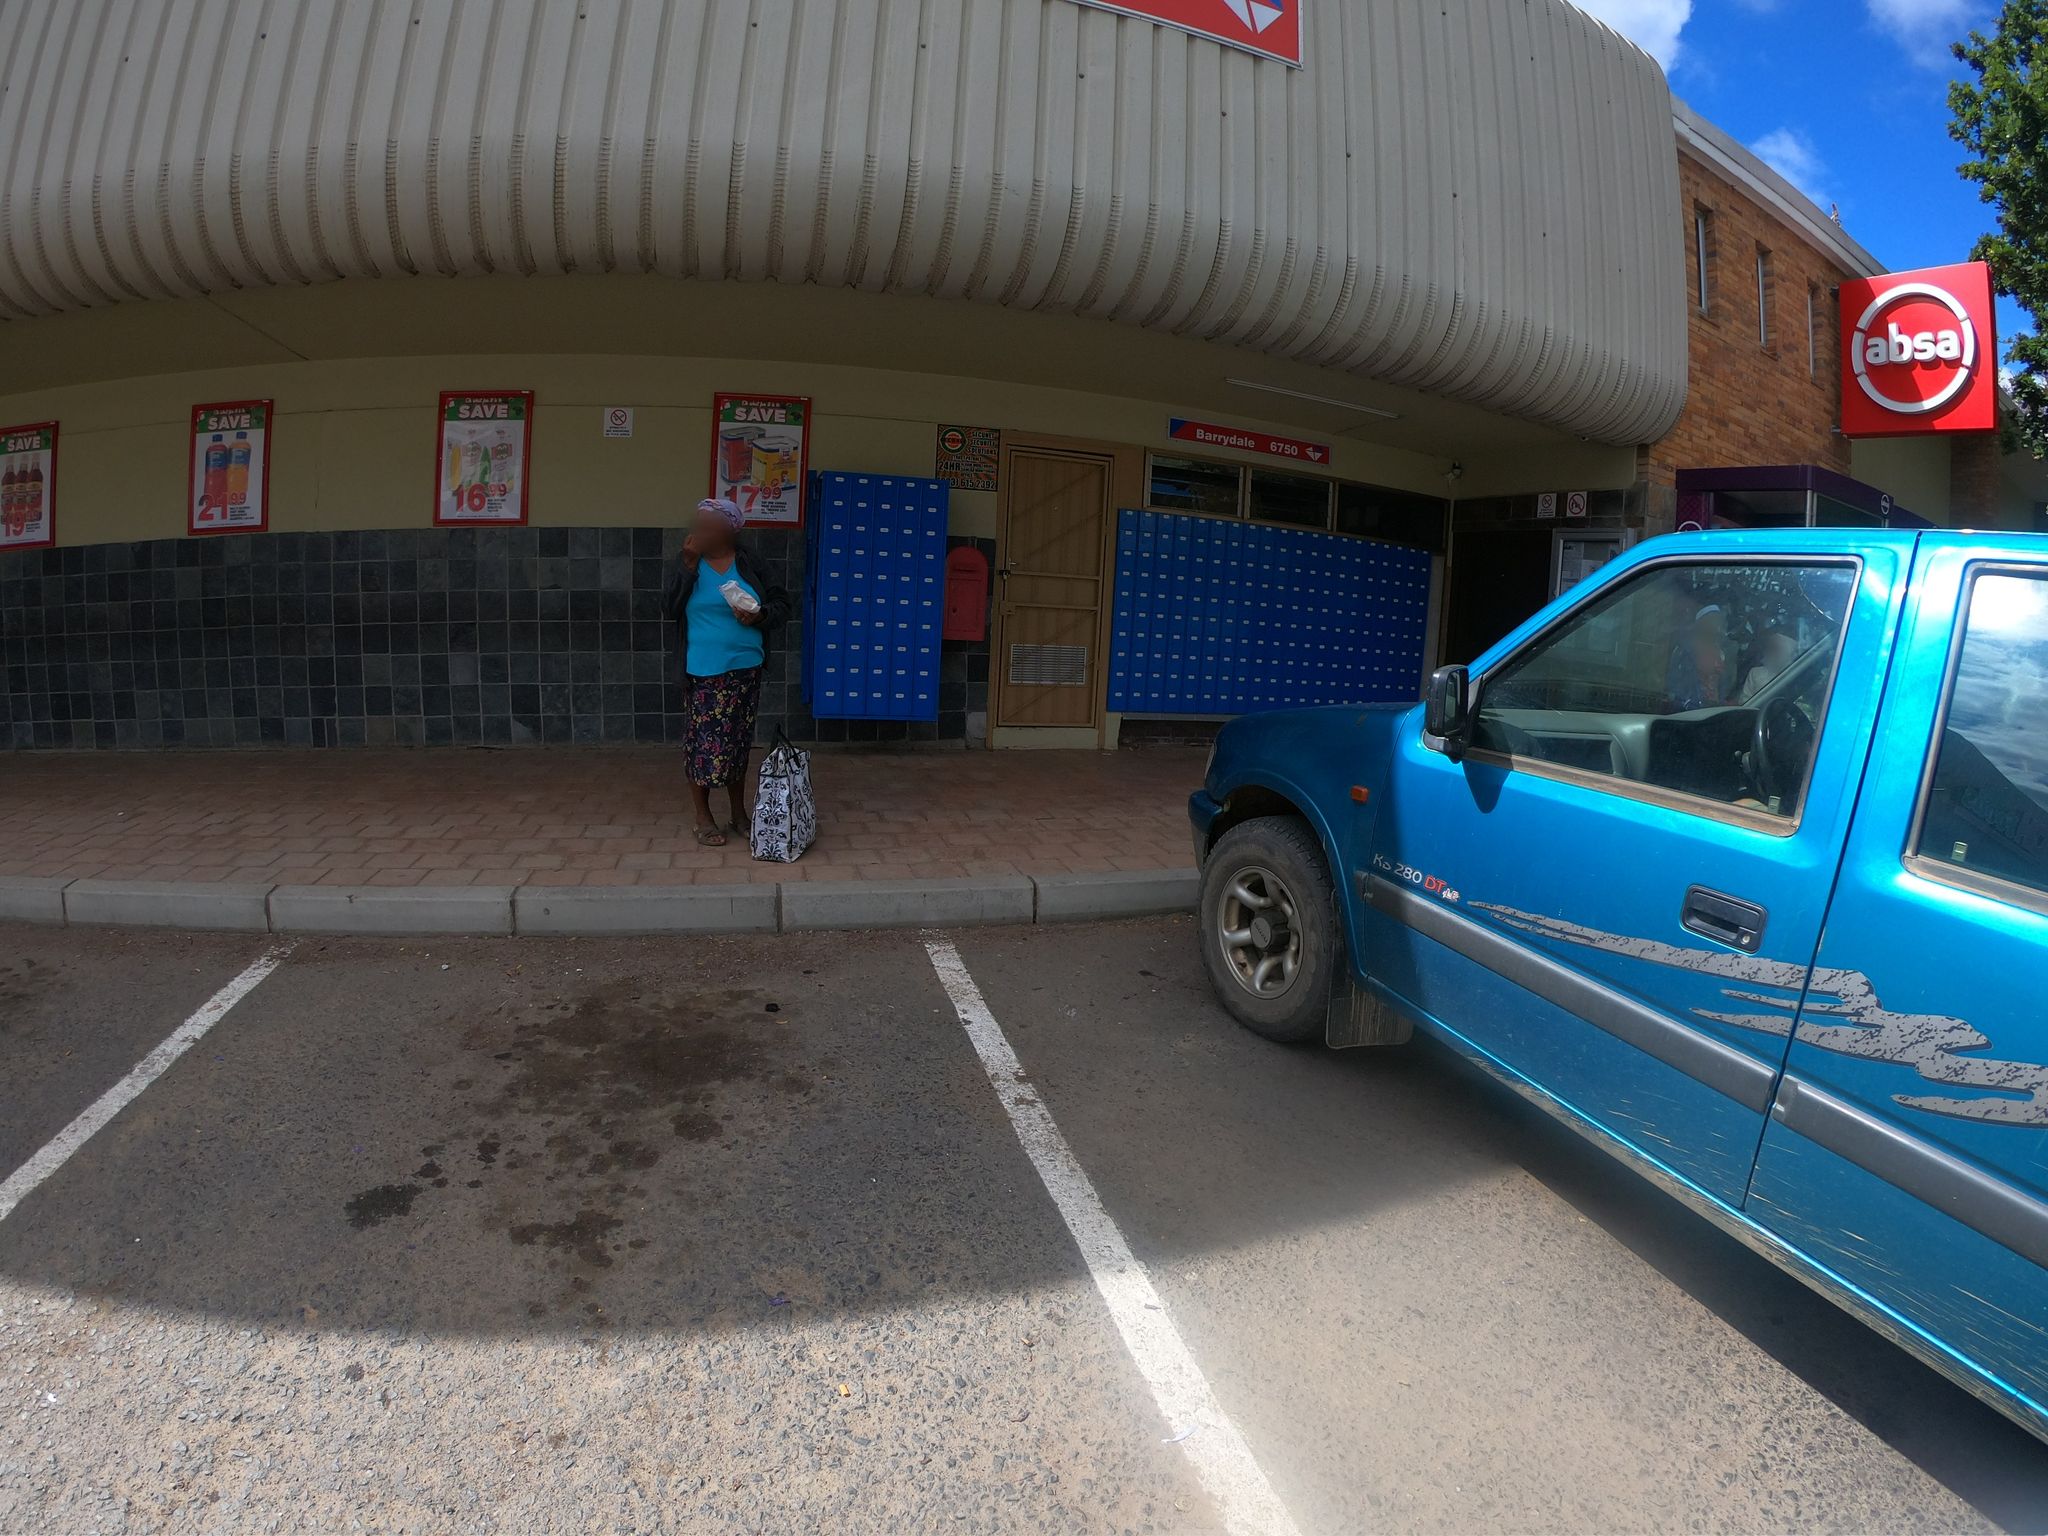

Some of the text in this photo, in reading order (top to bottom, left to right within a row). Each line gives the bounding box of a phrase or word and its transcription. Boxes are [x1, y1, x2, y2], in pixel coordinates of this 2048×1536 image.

[1866, 322, 1961, 365] absa
[208, 414, 251, 431] SAVE
[458, 404, 508, 419] SAVE
[734, 407, 786, 423] SAVE
[8, 435, 41, 452] SAVE
[1195, 428, 1298, 456] Barrydale 6750
[938, 461, 961, 472] 24HR
[199, 492, 228, 521] 21
[453, 483, 486, 512] 16
[1394, 862, 1422, 884] 280
[1425, 875, 1447, 893] DT
